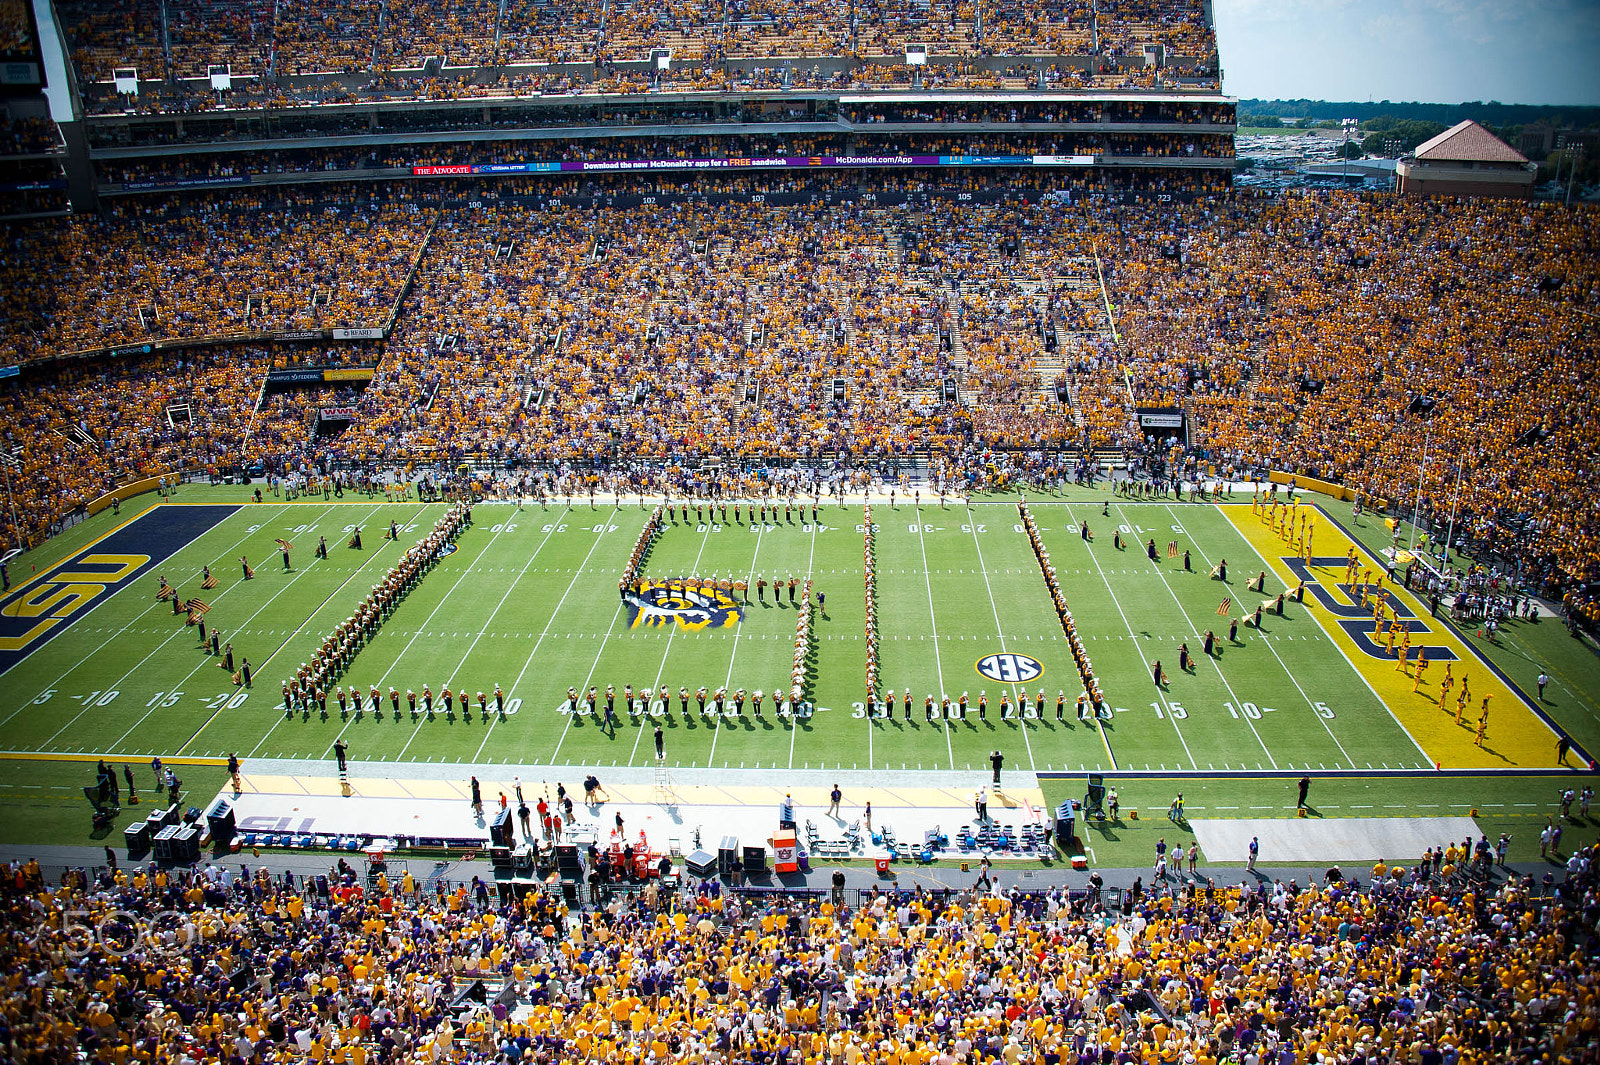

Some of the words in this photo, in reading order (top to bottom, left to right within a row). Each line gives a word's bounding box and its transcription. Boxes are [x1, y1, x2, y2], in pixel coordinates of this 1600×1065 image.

[583, 162, 619, 170] Download
[695, 161, 710, 169] app
[729, 158, 751, 166] FREE
[752, 158, 787, 166] sandwich
[836, 156, 913, 164] McDonalds.com/App
[432, 166, 470, 174] ADVOCATE
[1157, 194, 1171, 202] 223
[245, 524, 261, 533] 5
[292, 524, 319, 533] 10
[489, 523, 519, 533] 30
[541, 523, 569, 533] 35
[592, 523, 619, 533] 40
[696, 524, 723, 533] 50
[749, 524, 776, 533] 45
[802, 524, 829, 533] 40
[908, 524, 942, 533] 30
[960, 524, 987, 533] 25
[1118, 524, 1145, 534] 10
[1169, 524, 1184, 534] 5
[1279, 557, 1462, 661] LSU
[976, 653, 1044, 682] SEC
[33, 689, 59, 704] 5
[81, 690, 121, 706] 10
[145, 691, 185, 708] 15
[205, 693, 249, 709] 20
[485, 698, 524, 715] 40
[556, 700, 592, 716] 45
[632, 700, 666, 717] 50
[704, 700, 741, 717] 45
[780, 701, 814, 718] 40
[851, 702, 888, 719] 35
[1002, 702, 1038, 719] 25
[1150, 702, 1189, 719] 15
[1223, 702, 1263, 719] 10
[1314, 702, 1336, 719] 5
[1016, 1026, 1023, 1035] 7
